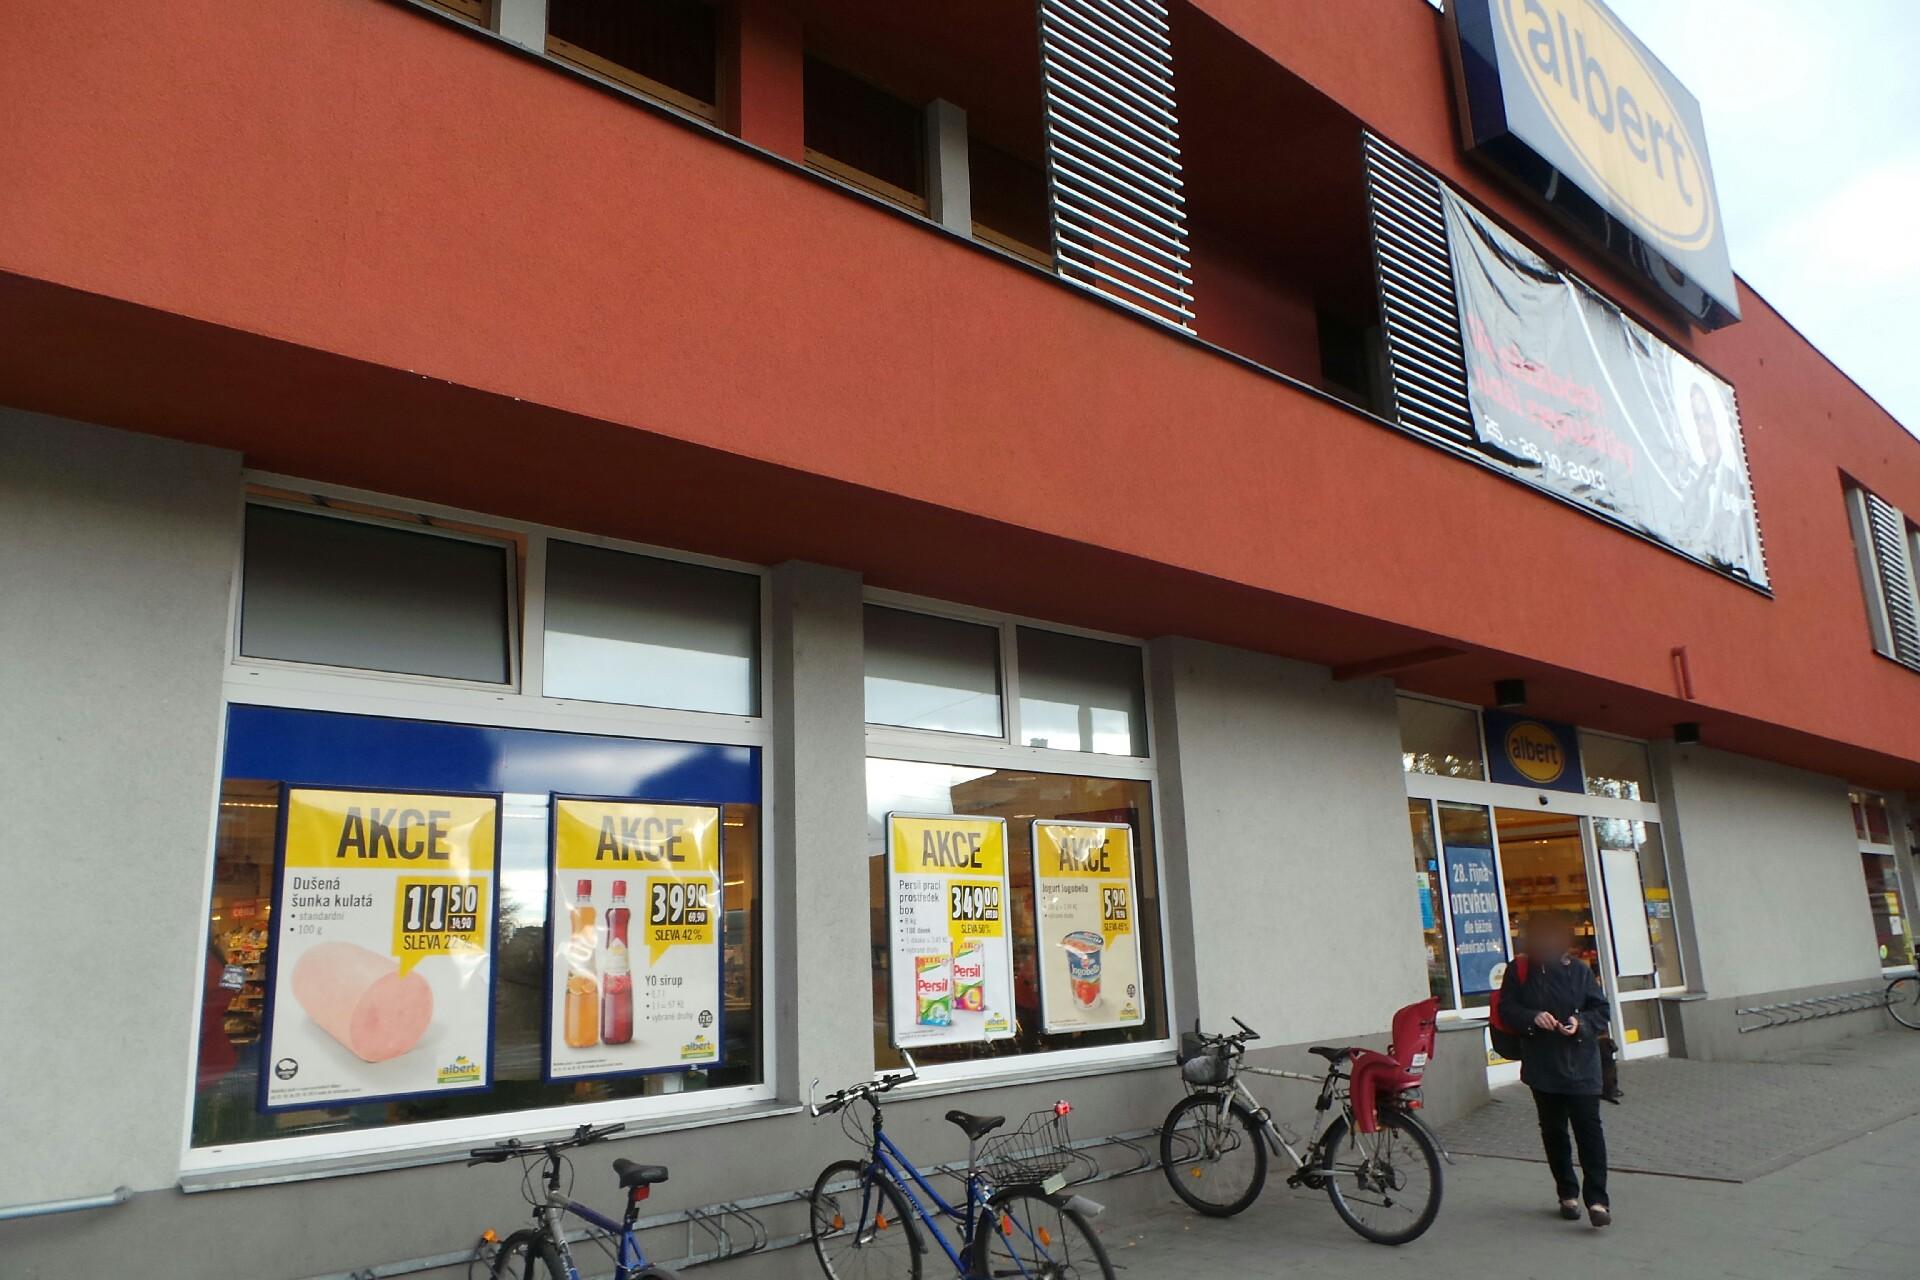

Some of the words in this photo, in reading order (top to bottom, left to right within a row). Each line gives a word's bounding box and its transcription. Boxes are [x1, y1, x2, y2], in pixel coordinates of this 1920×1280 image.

[1525, 0, 1694, 208] albert
[1511, 735, 1559, 765] albert
[336, 806, 452, 860] AKCE
[595, 815, 685, 862] AKCE
[922, 829, 982, 868] AKCE
[1452, 863, 1468, 883] 28.
[293, 876, 340, 890] Dušená
[291, 892, 330, 908] šunka
[334, 893, 373, 908] kulatá
[1451, 889, 1498, 915] OTEVŘENO
[899, 904, 915, 915] box
[403, 934, 440, 950] SLEVA
[655, 930, 680, 941] SLEVA
[952, 964, 981, 978] Persil
[917, 978, 948, 993] Persil
